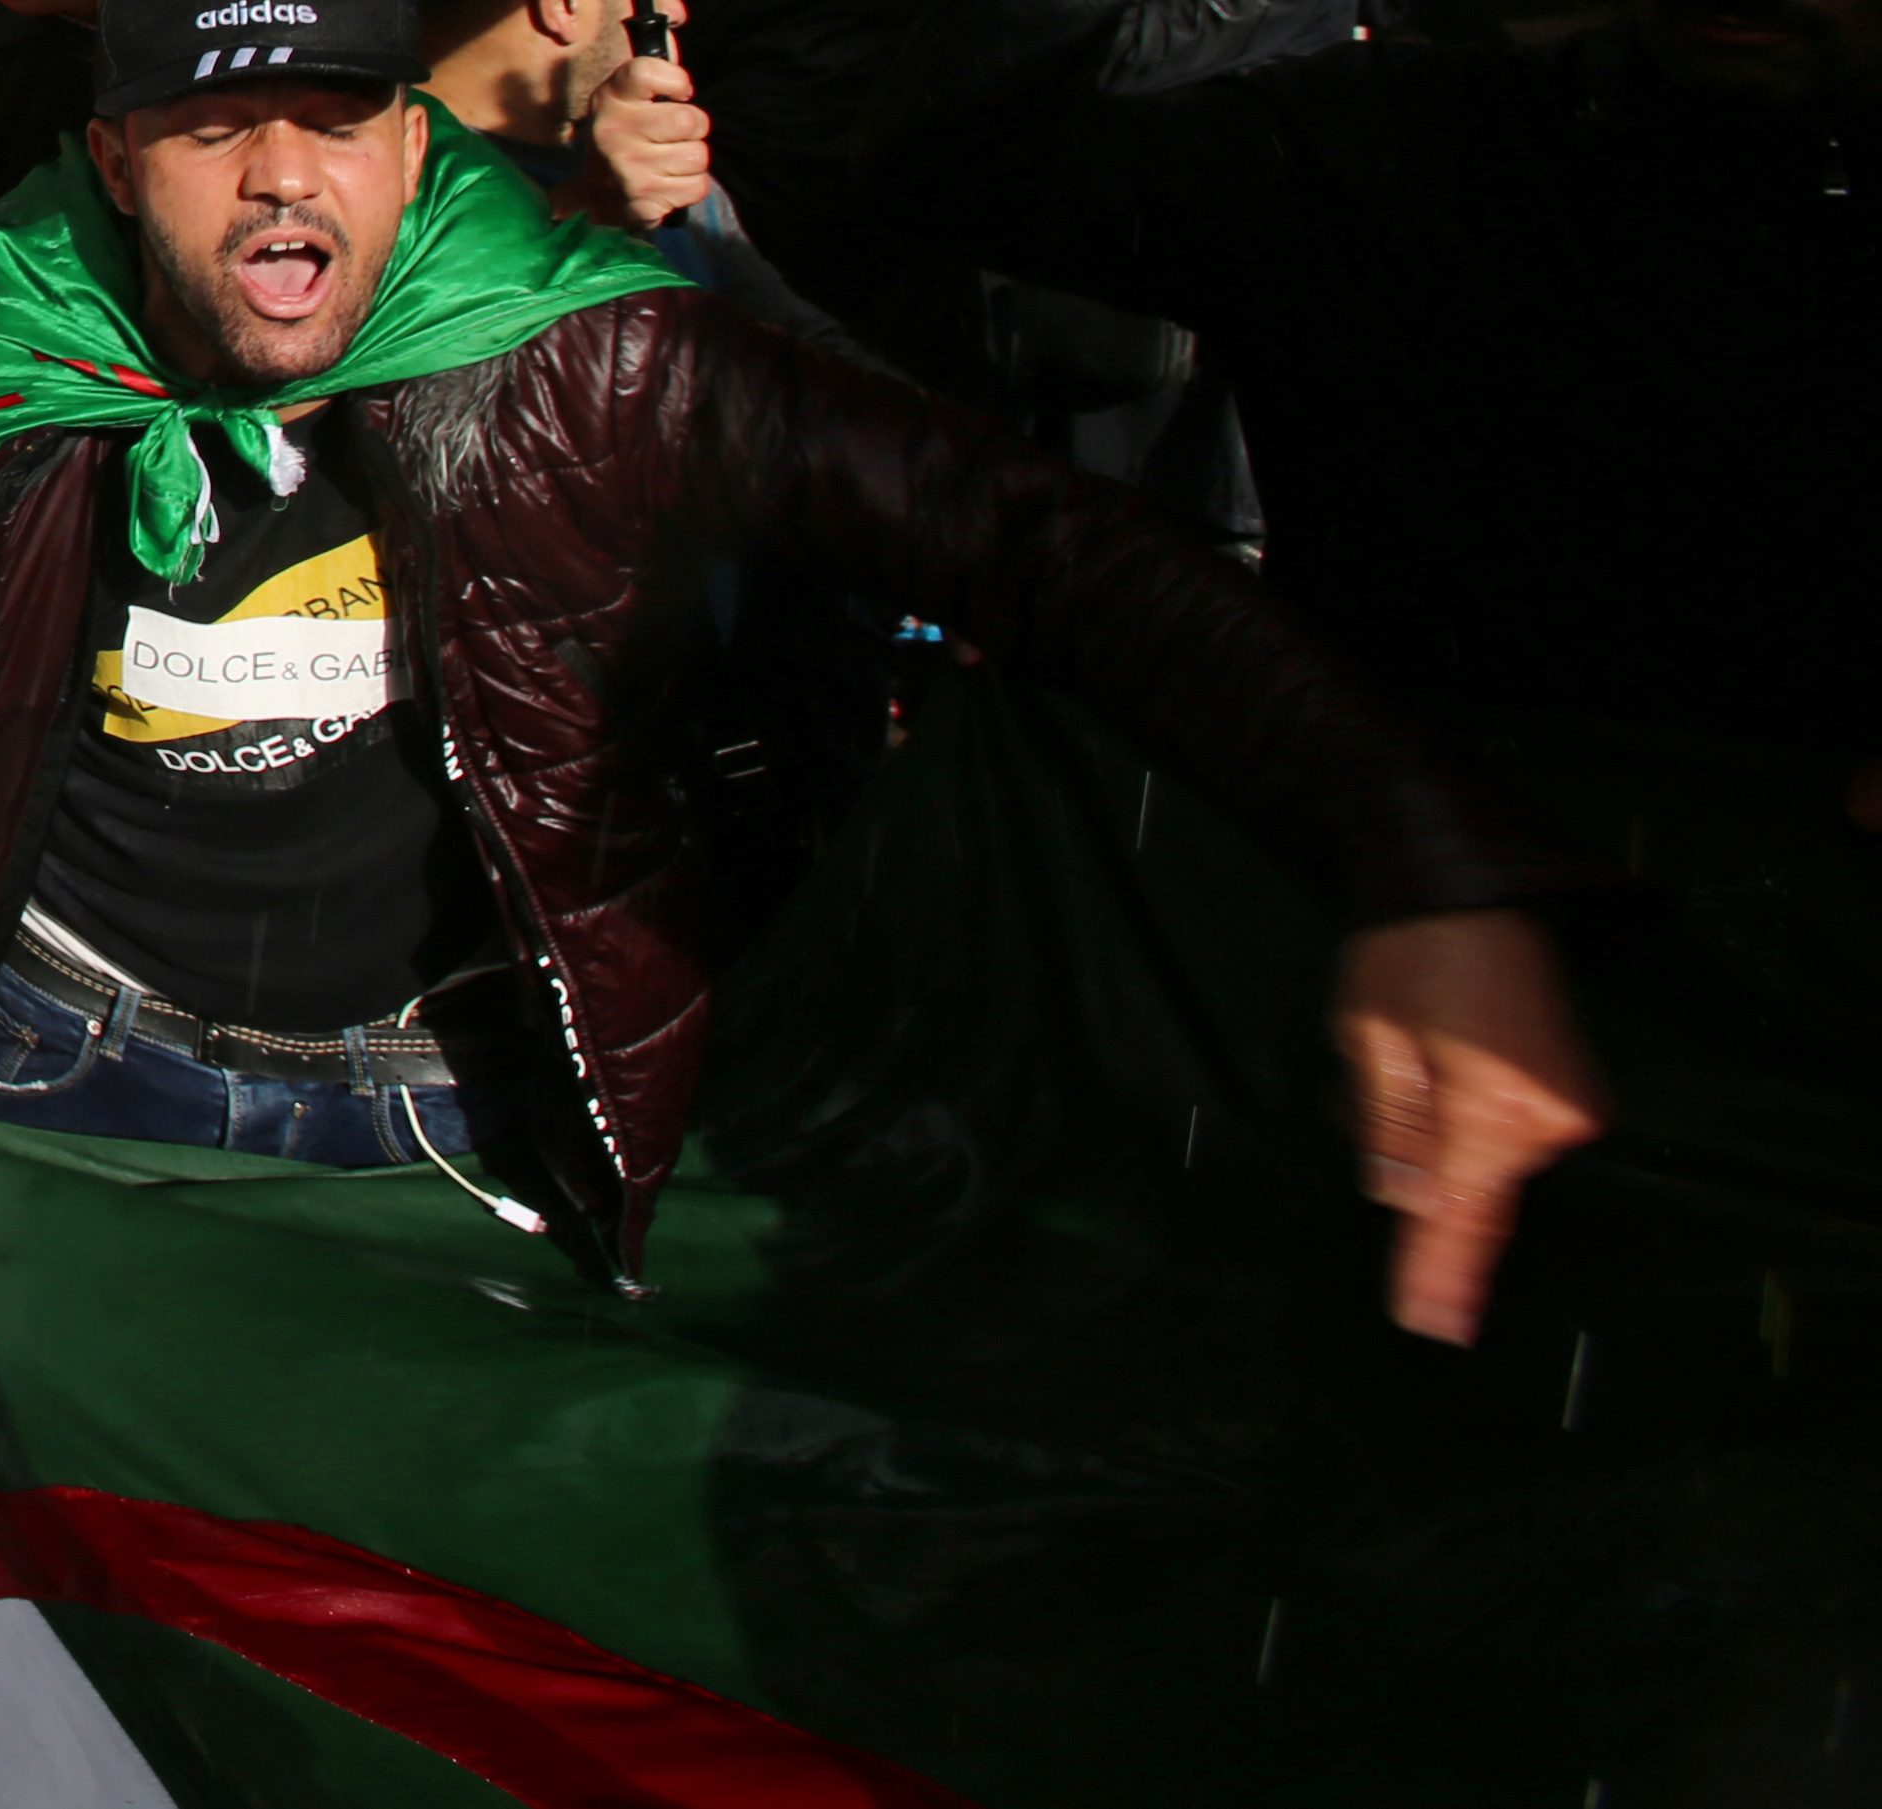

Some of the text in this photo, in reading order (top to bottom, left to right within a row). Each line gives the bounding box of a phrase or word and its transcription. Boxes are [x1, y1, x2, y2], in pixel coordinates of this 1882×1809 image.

[195, 0, 319, 30] adidas
[132, 639, 276, 684] DOLCE
[283, 660, 300, 681] &
[154, 733, 295, 774] DOLCE
[292, 736, 316, 759] &
